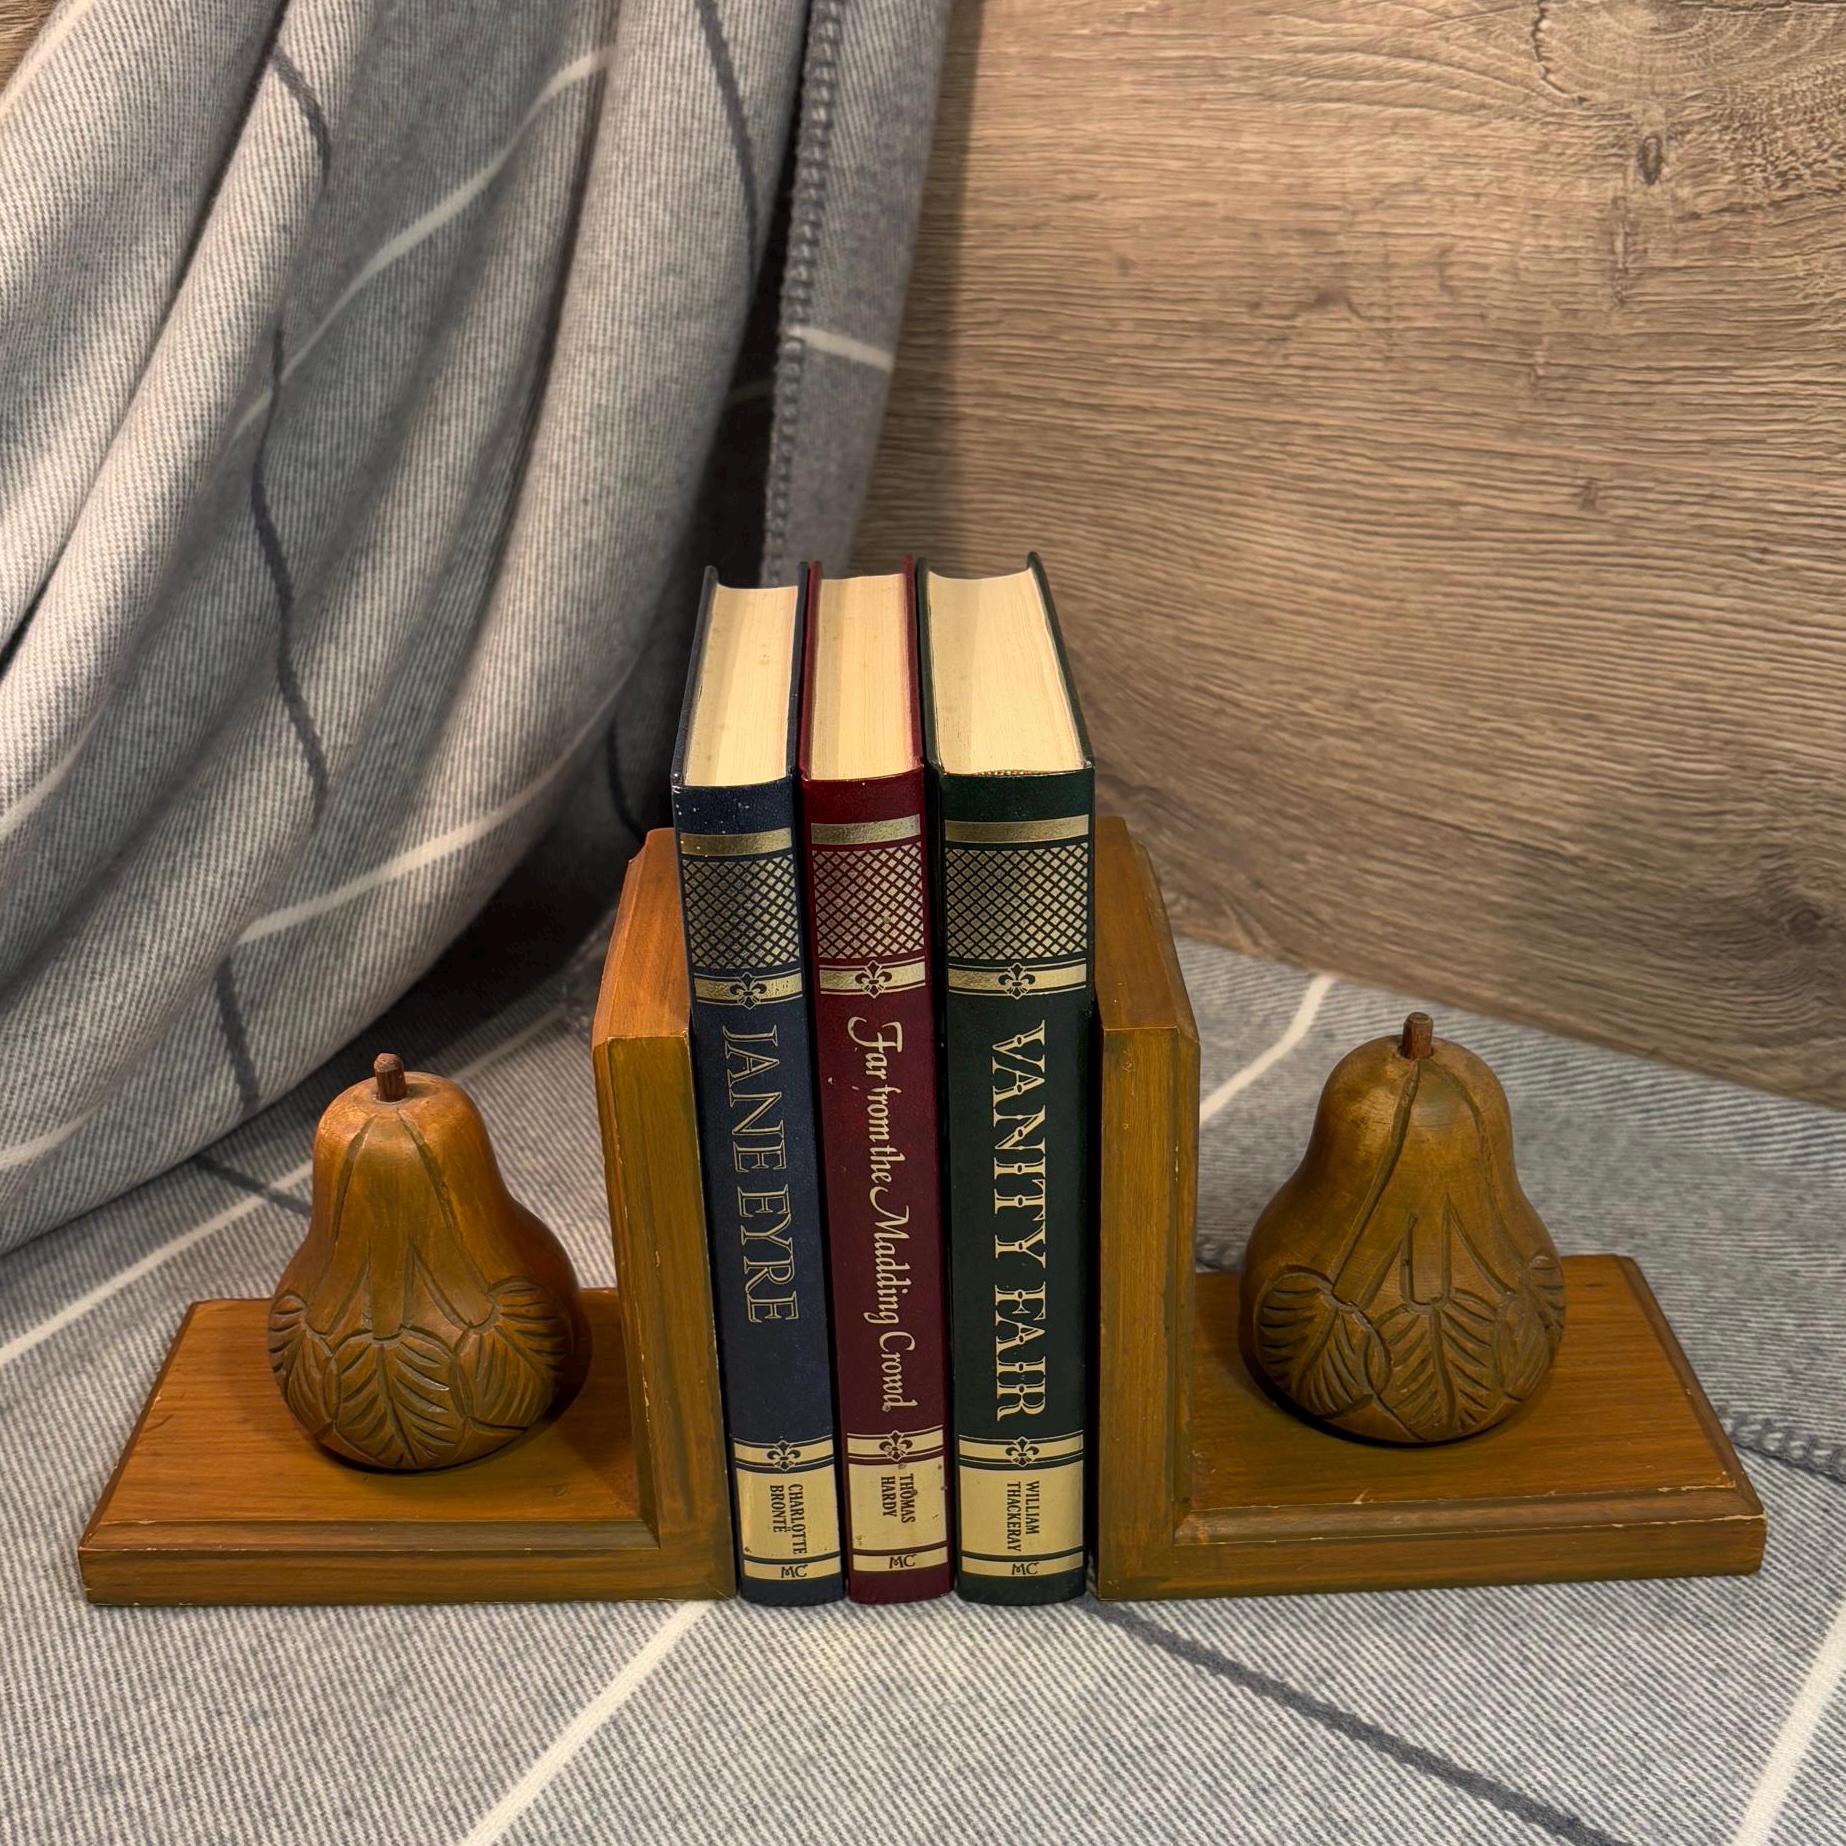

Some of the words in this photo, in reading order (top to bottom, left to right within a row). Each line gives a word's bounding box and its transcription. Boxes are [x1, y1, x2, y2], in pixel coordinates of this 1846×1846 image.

[847, 1016, 903, 1080] Far
[722, 1024, 787, 1173] JANE
[866, 1084, 902, 1143] from
[869, 1144, 906, 1184] the
[991, 1019, 1047, 1269] VANITY
[737, 1183, 800, 1323] EYRE
[863, 1186, 912, 1325] Madding
[879, 1331, 919, 1412] Crowd
[994, 1280, 1047, 1422] FAIR
[769, 1484, 790, 1533] BRONTË
[788, 1483, 808, 1555] CHARLOTTE
[881, 1476, 898, 1517] HARDY
[899, 1473, 916, 1524] THOMAS
[1006, 1481, 1022, 1552] THACKERAY
[1025, 1480, 1040, 1535] WILLIAM
